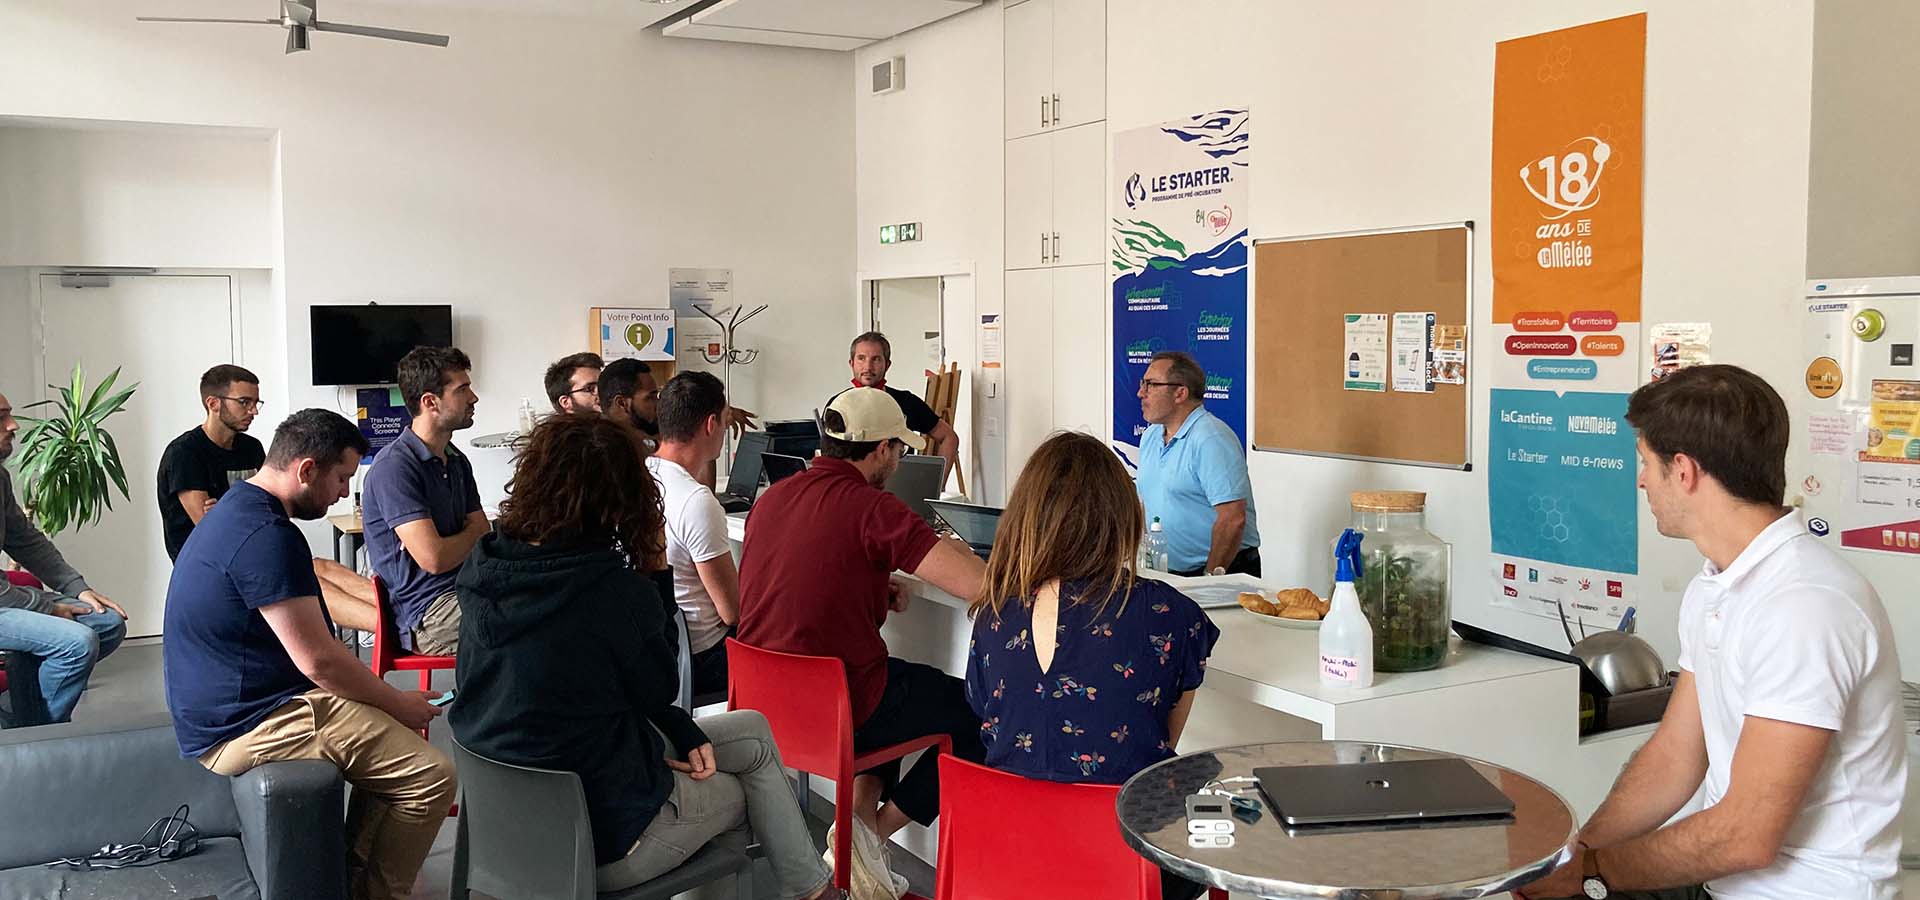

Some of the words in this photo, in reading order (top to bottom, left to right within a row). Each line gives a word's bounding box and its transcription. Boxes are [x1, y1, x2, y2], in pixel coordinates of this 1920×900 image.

[1538, 152, 1589, 204] 18
[1151, 176, 1167, 193] LE
[1152, 193, 1178, 202] PROGRAMME
[1184, 188, 1222, 199] PRÉ-INCUBATION
[1536, 222, 1575, 239] ans
[1577, 222, 1592, 233] DE
[607, 313, 630, 321] Votre
[631, 313, 652, 321] Point
[653, 313, 670, 321] Info
[1572, 317, 1613, 326] #Territoires
[1512, 341, 1569, 351] #OpenInnovation
[1586, 341, 1618, 350] #Talents
[1533, 364, 1591, 375] #Entrepreneuriat
[384, 417, 402, 425] Player
[1501, 409, 1553, 425] laCantine
[371, 422, 401, 430] Connects
[1507, 448, 1516, 461] Le
[1518, 448, 1549, 464] Starter
[1560, 455, 1580, 467] MID
[1582, 456, 1624, 470] e-news
